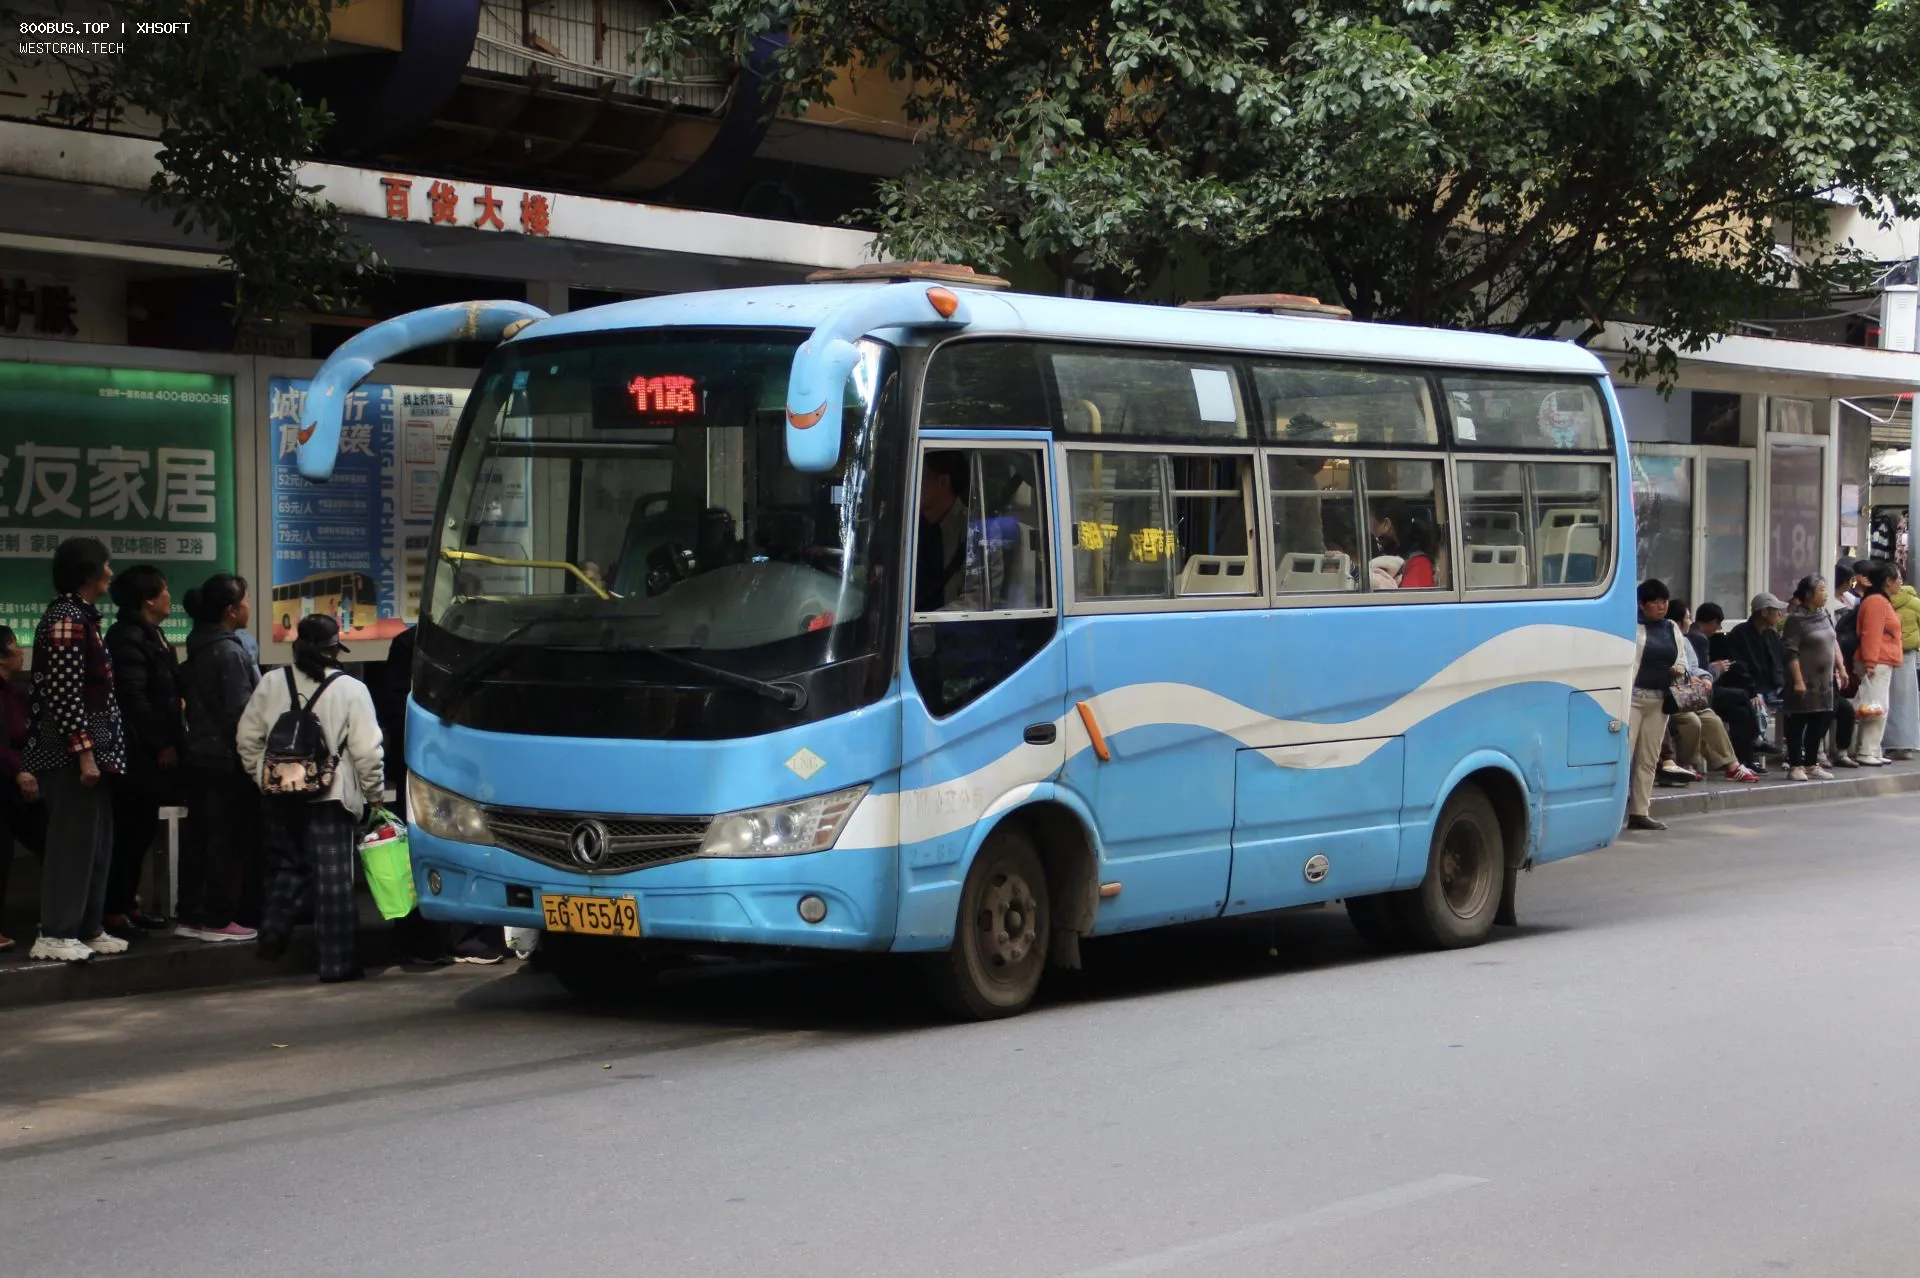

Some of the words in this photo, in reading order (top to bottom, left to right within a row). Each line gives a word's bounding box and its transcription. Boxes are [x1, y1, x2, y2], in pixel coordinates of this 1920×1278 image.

[380, 177, 549, 235] 百货大楼
[155, 389, 229, 405] 400-8800-315
[629, 375, 696, 412] 11路
[177, 538, 204, 554] 卫浴
